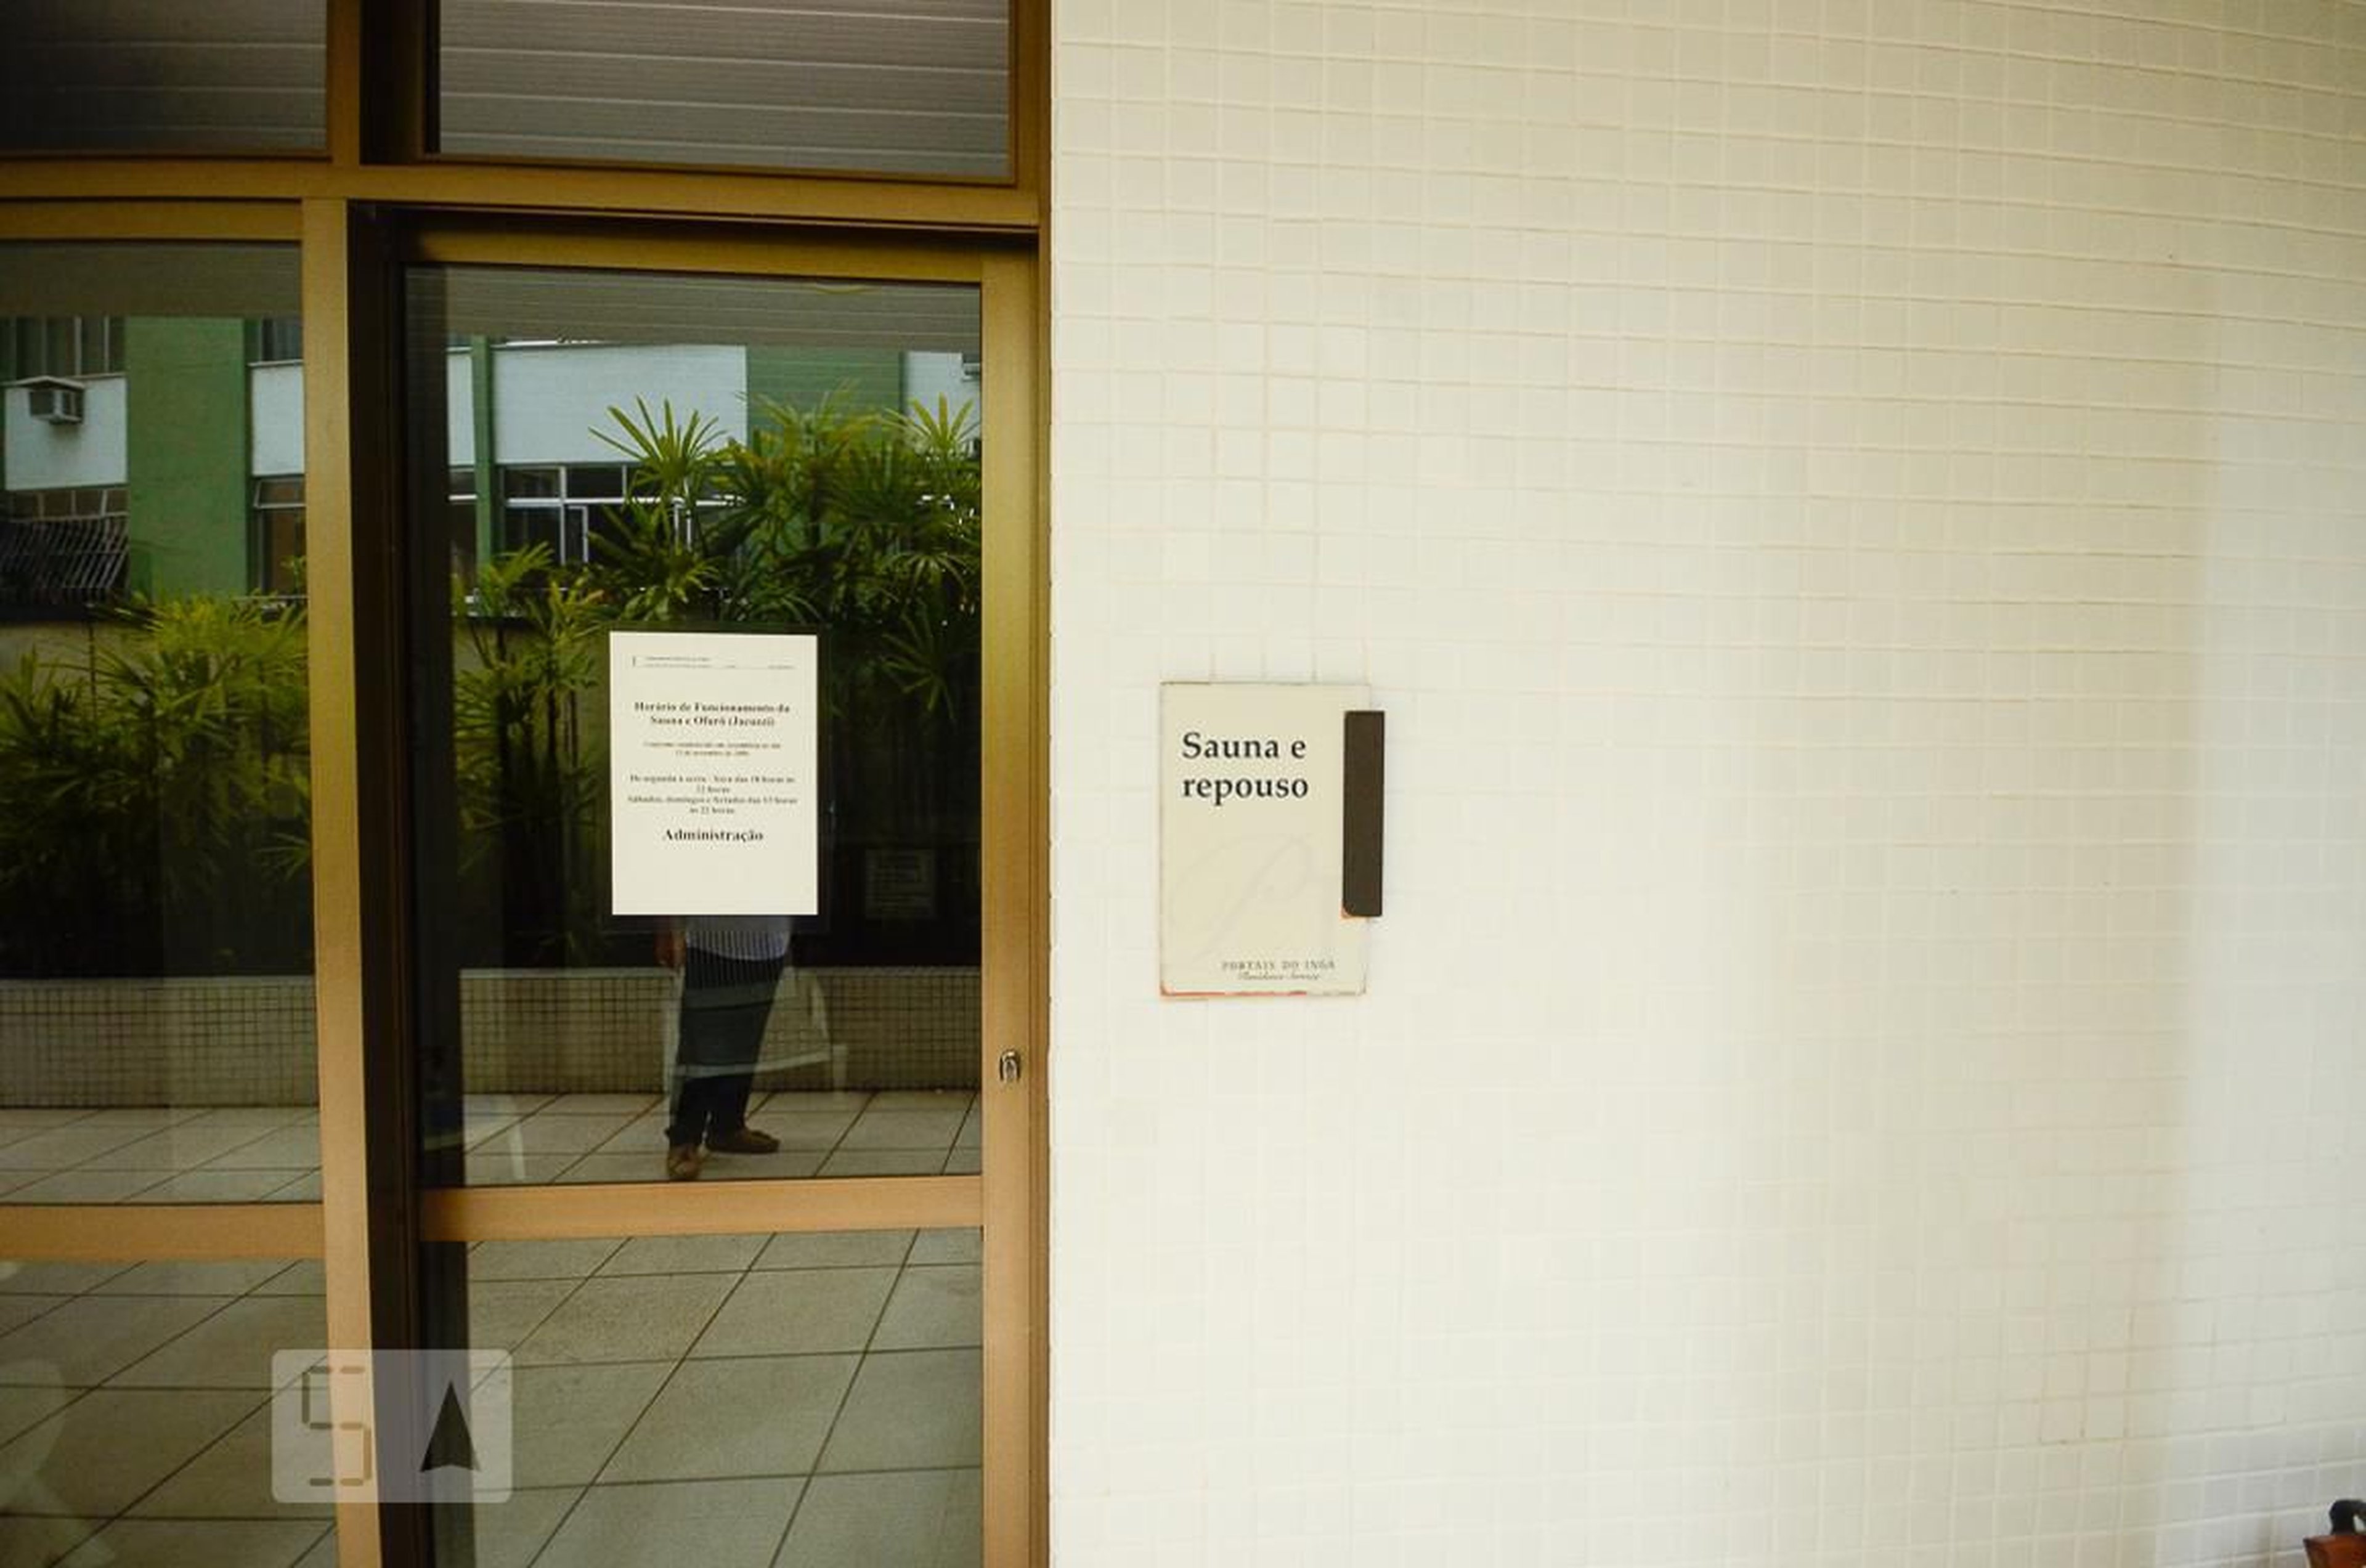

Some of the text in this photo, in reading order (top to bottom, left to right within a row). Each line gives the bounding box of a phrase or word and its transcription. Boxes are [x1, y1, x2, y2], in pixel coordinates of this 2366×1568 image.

[634, 701, 790, 713] Horário de Funcionamento da
[651, 715, 683, 725] Sauna
[1181, 731, 1306, 759] Sauna e
[1182, 778, 1309, 806] repouso
[664, 828, 764, 843] Administração
[1222, 960, 1275, 970] PORTAIS
[1282, 960, 1299, 970] DO
